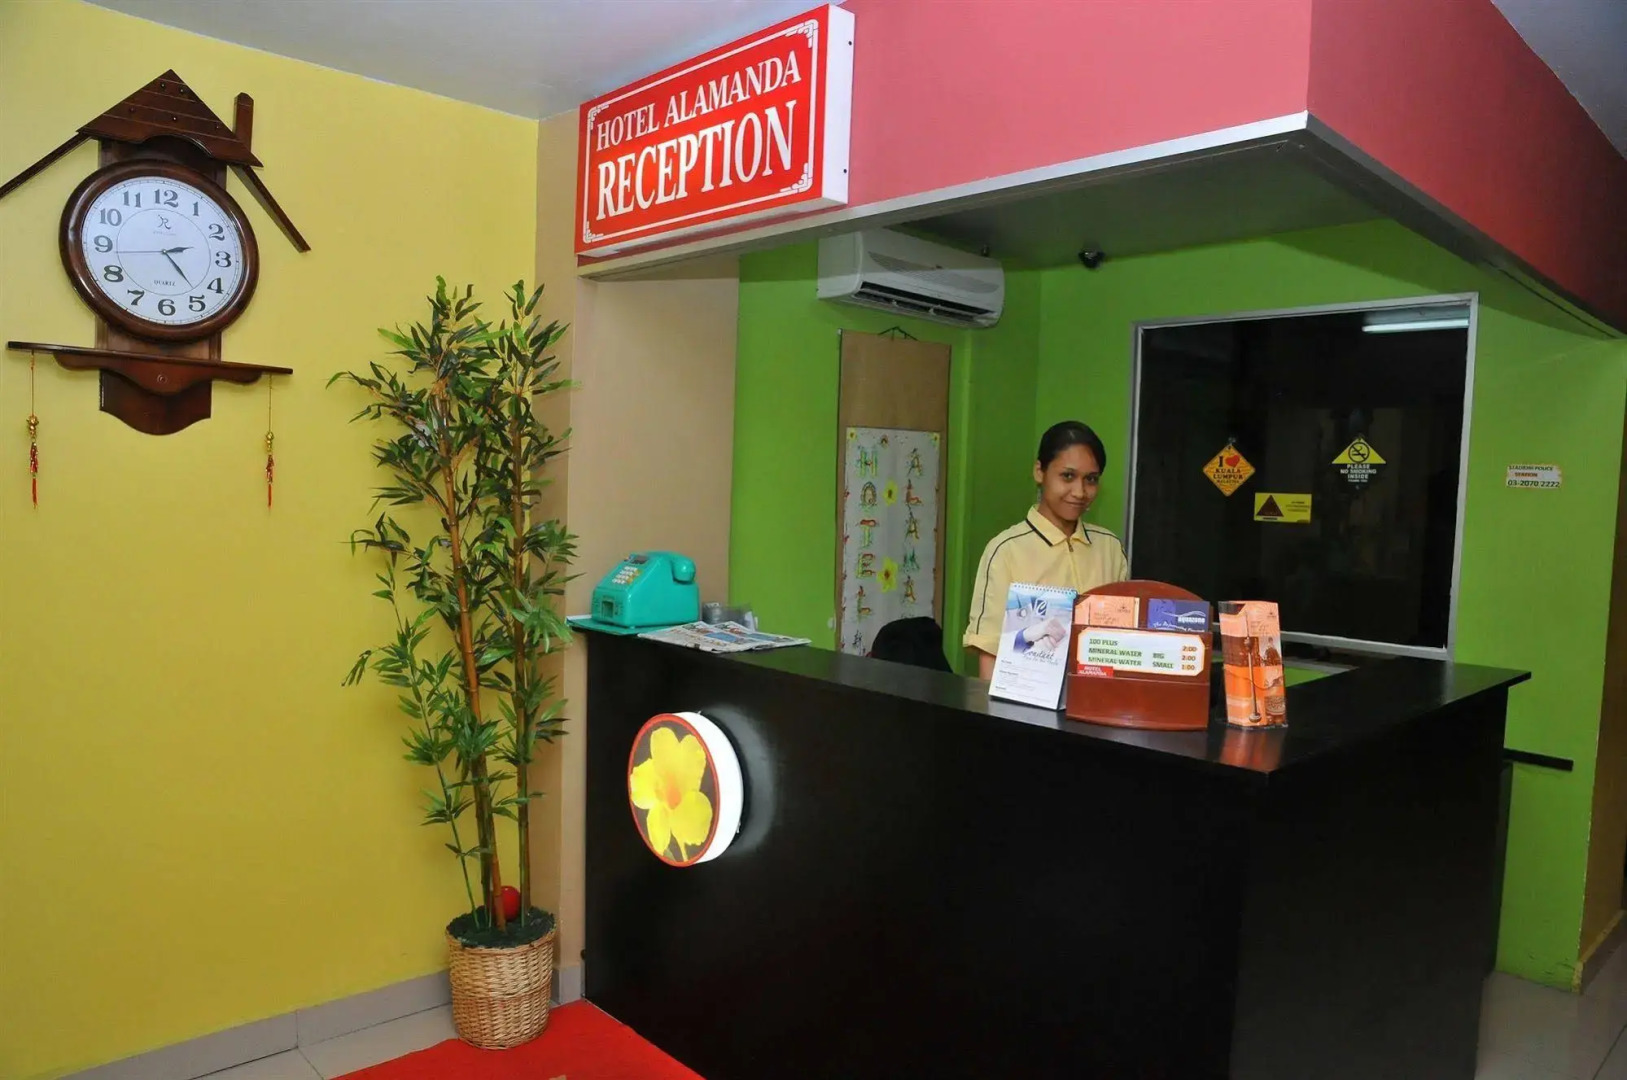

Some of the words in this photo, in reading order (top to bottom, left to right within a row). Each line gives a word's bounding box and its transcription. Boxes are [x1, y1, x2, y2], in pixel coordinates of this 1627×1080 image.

[596, 103, 660, 152] HOTEL
[664, 50, 802, 128] ALAMANDA
[596, 100, 797, 220] RECEPTION
[123, 190, 141, 208] 11
[154, 188, 179, 208] 12
[100, 208, 122, 226] 10
[193, 202, 199, 217] 1
[208, 224, 225, 241] 2
[93, 235, 113, 253] 9
[215, 251, 232, 268] 3
[103, 264, 124, 283] 8
[153, 279, 177, 287] QUARTZ
[206, 277, 224, 294] 4
[127, 289, 145, 306] 7
[188, 294, 206, 312] 5
[157, 299, 176, 316] 6
[1218, 455, 1224, 467] I
[1088, 648, 1118, 656] MINERAL
[1088, 656, 1117, 665] MINERAL
